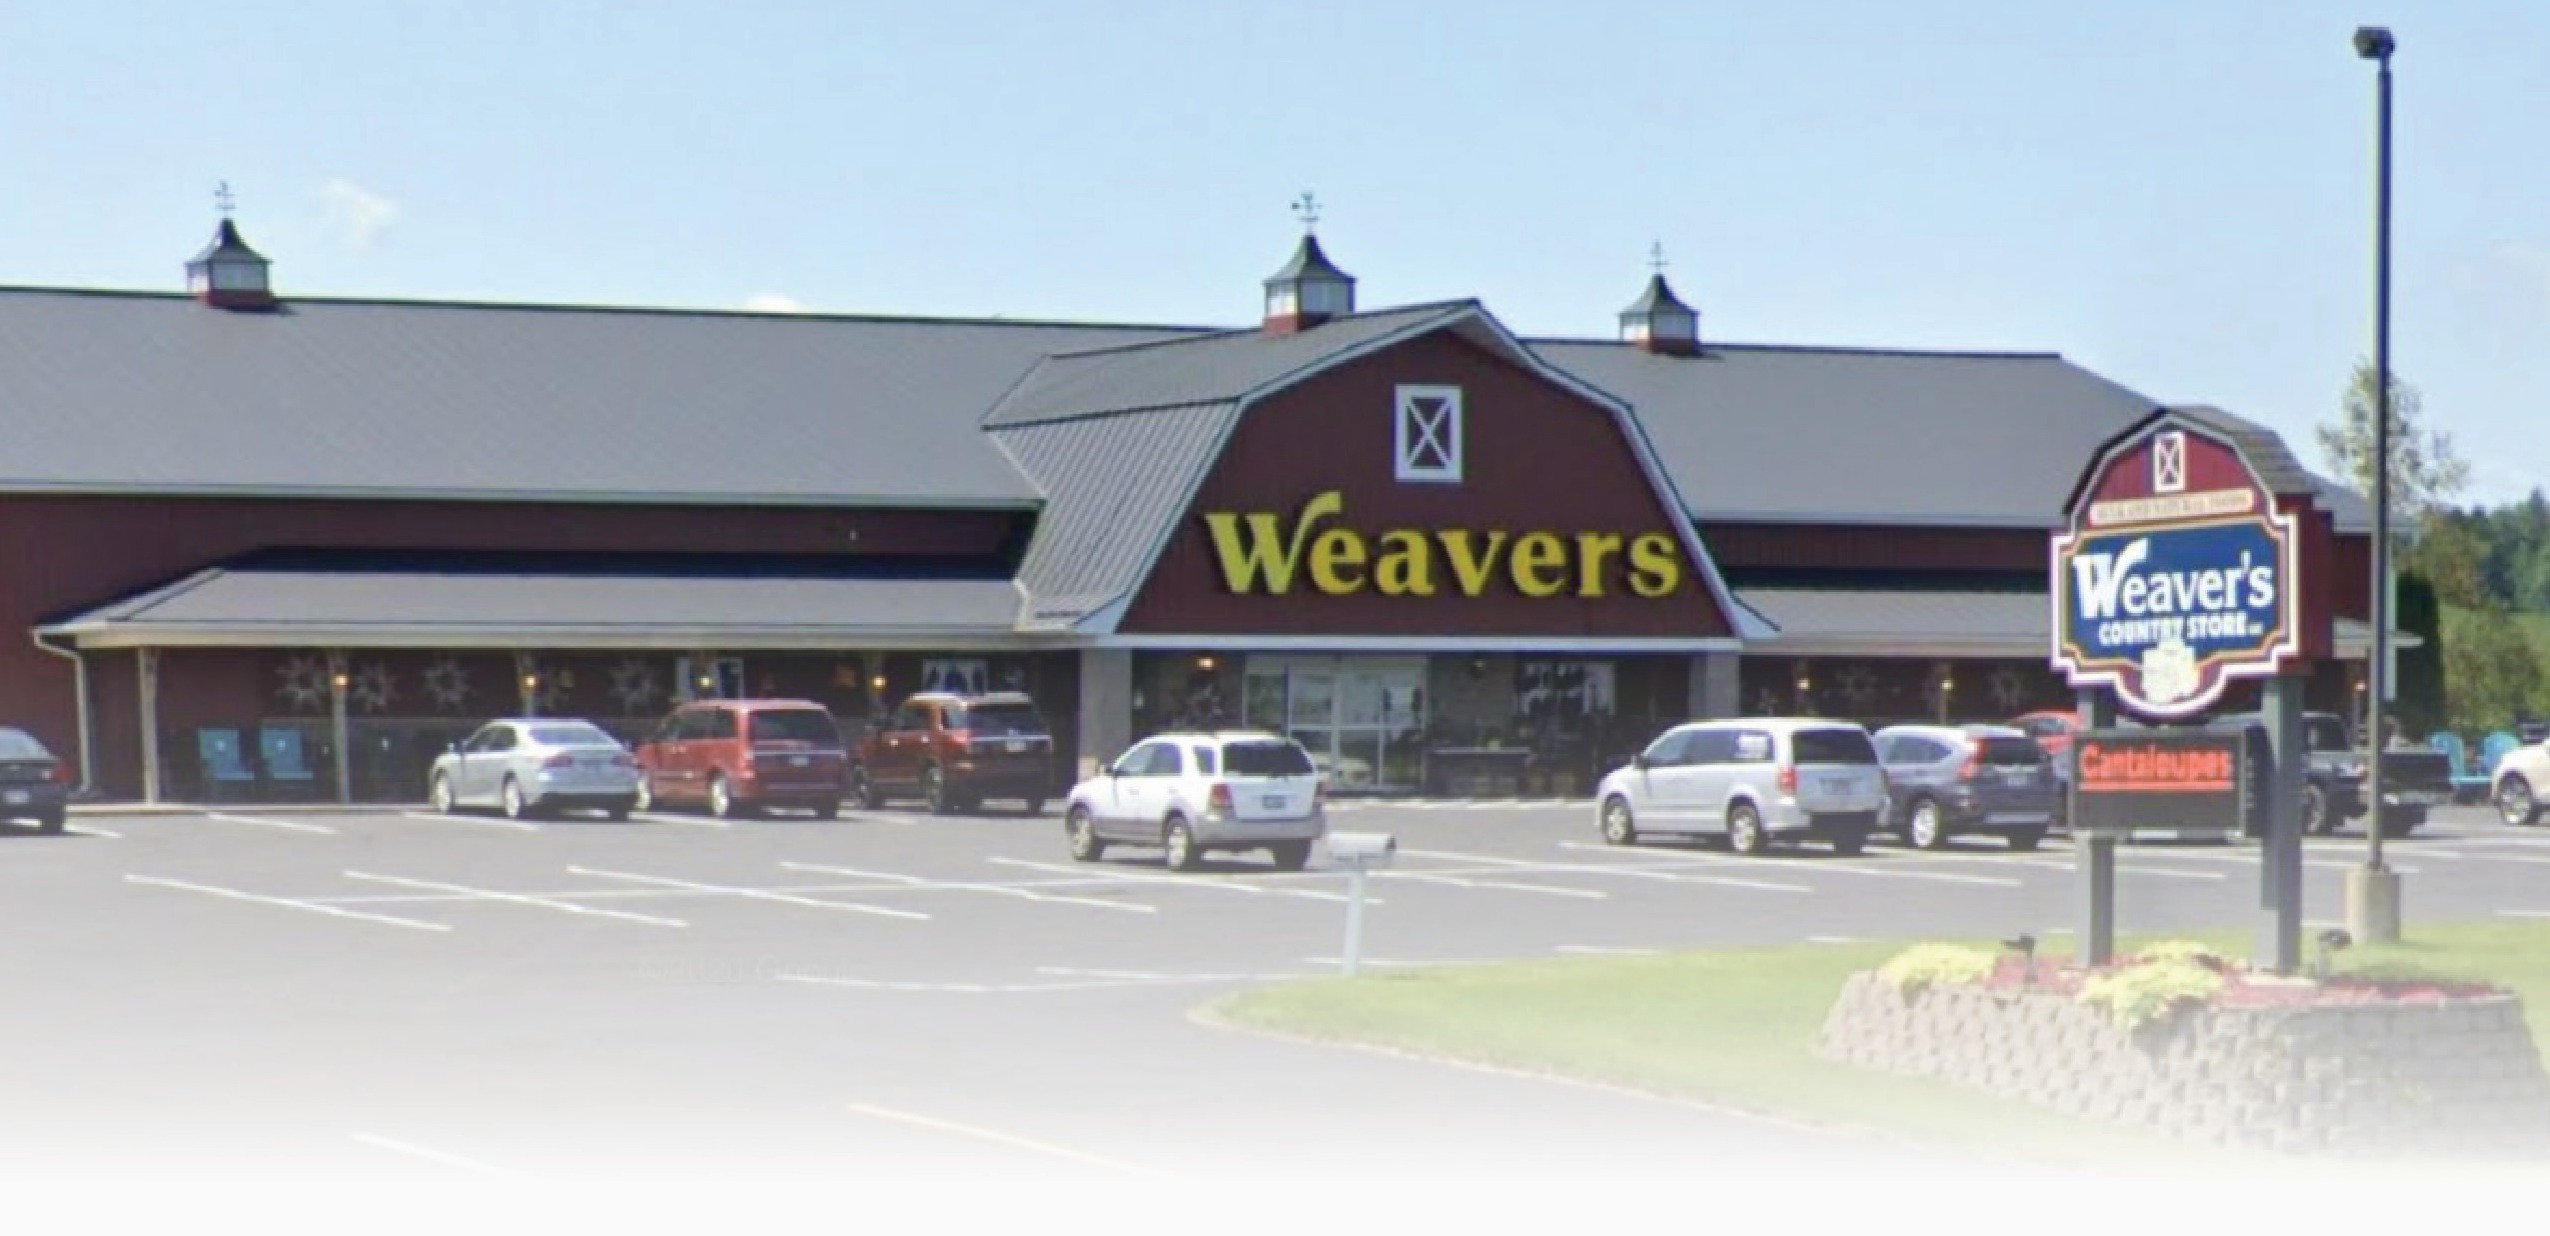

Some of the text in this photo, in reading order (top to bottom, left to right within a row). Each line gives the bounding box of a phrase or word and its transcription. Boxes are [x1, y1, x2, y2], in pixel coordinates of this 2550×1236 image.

[1204, 491, 1680, 597] Weavers
[2072, 537, 2275, 620] Weaver's
[2098, 616, 2184, 646] COUNTRY
[2187, 611, 2247, 639] STORE
[2080, 744, 2233, 779] Cantaloupes
